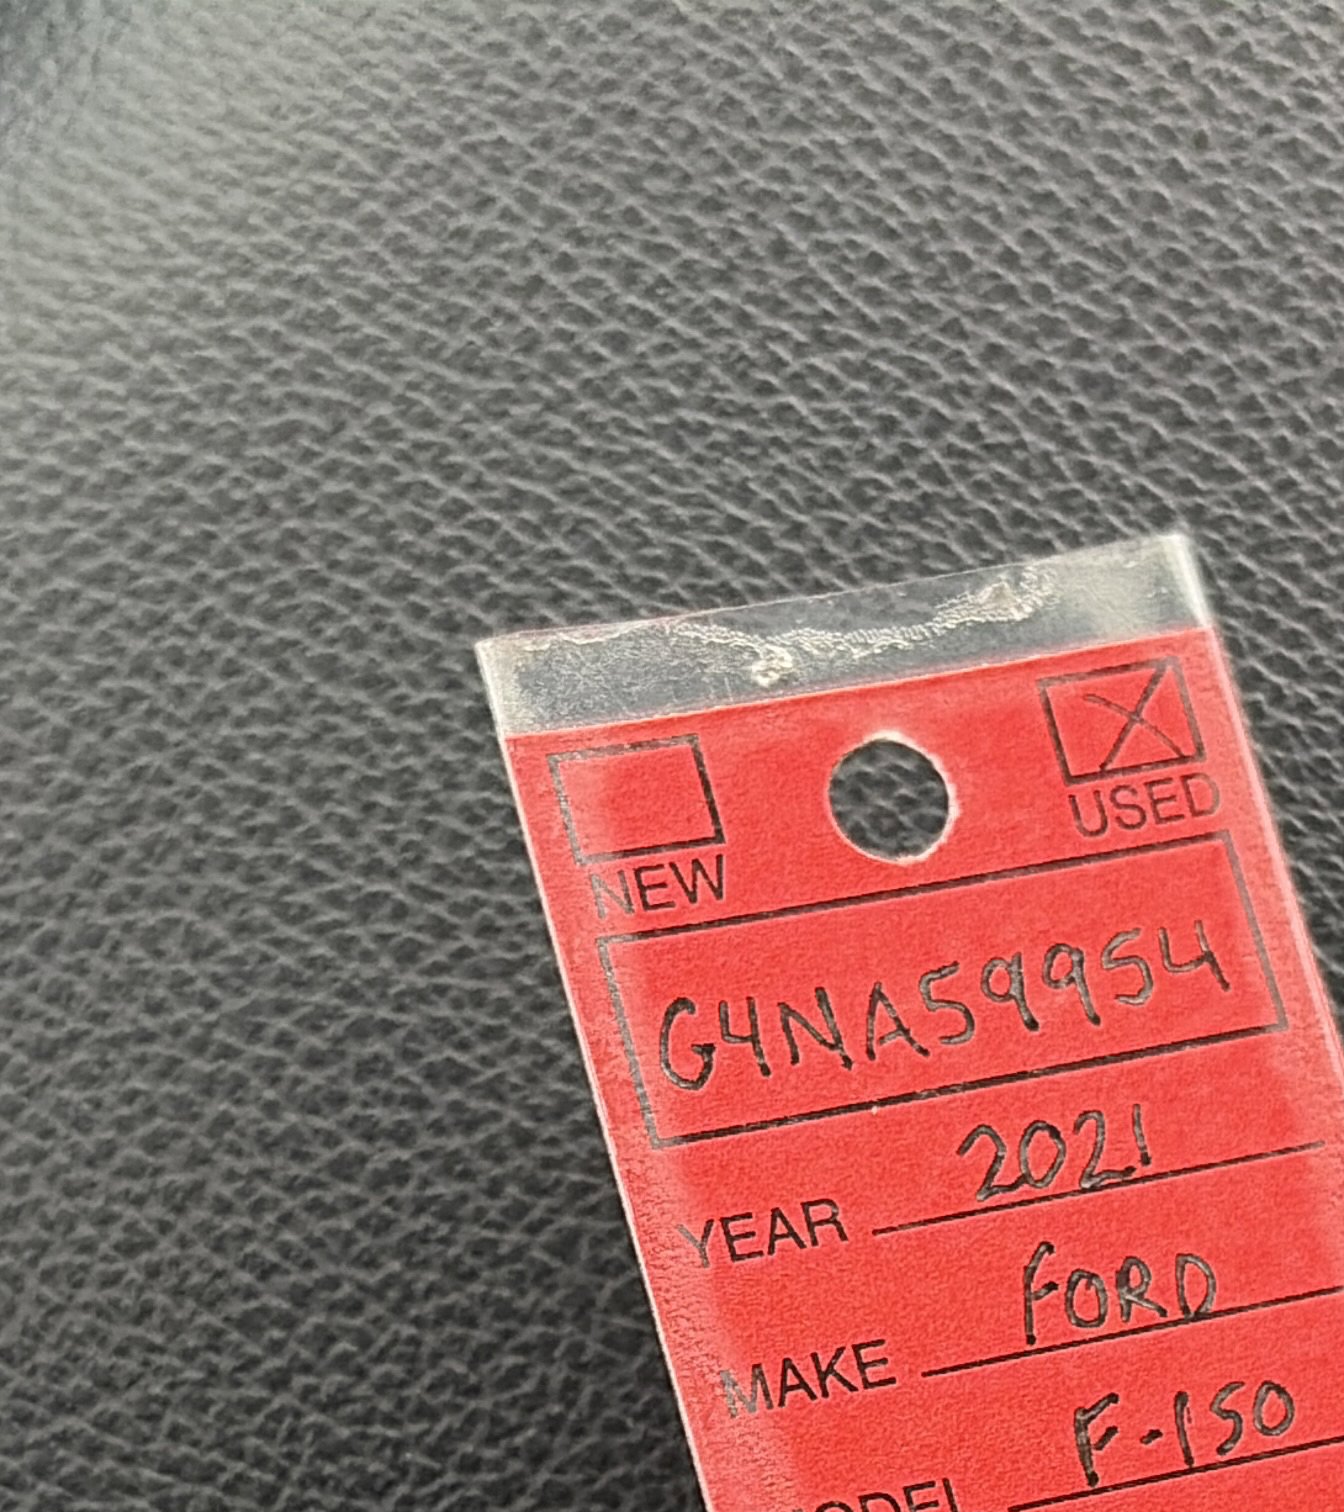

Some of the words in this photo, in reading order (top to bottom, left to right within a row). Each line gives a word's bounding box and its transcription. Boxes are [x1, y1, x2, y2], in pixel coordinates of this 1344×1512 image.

[1068, 774, 1220, 837] USED
[587, 855, 727, 919] NEW
[659, 920, 1230, 1090] G4NA59954
[956, 1105, 1152, 1202] 2021
[678, 1199, 849, 1269] YEAR
[1024, 1241, 1216, 1345] FORD
[718, 1338, 897, 1418] MAKE
[1074, 1380, 1294, 1486] F-150
